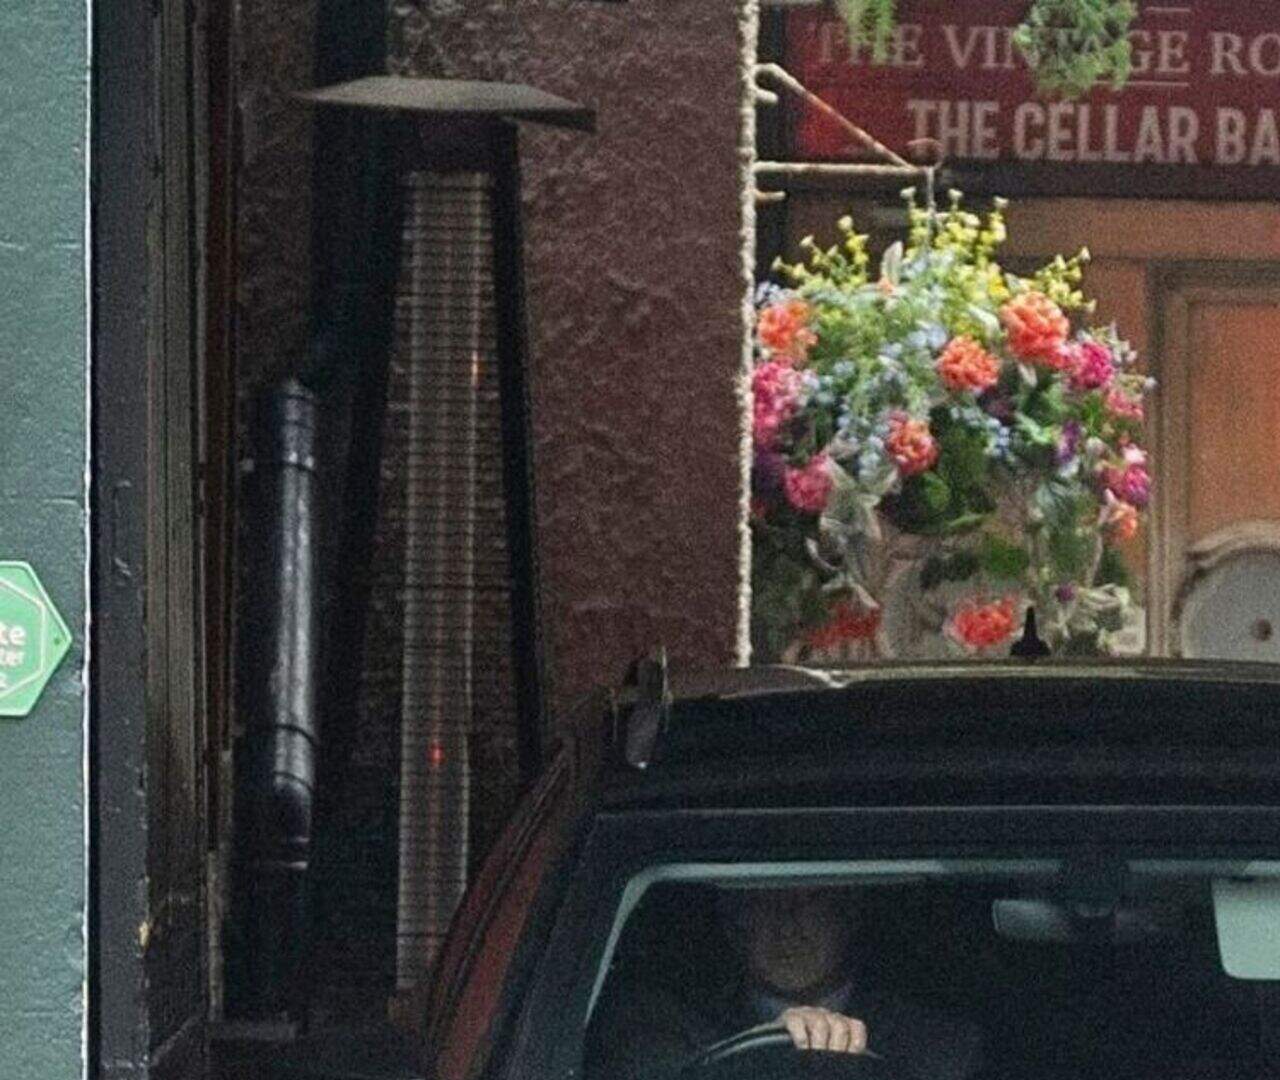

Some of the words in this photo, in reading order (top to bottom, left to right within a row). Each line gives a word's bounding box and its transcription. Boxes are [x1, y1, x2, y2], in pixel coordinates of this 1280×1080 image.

[944, 24, 1190, 74] VINGE
[907, 100, 999, 159] THE
[1014, 101, 1199, 164] CELLAR
